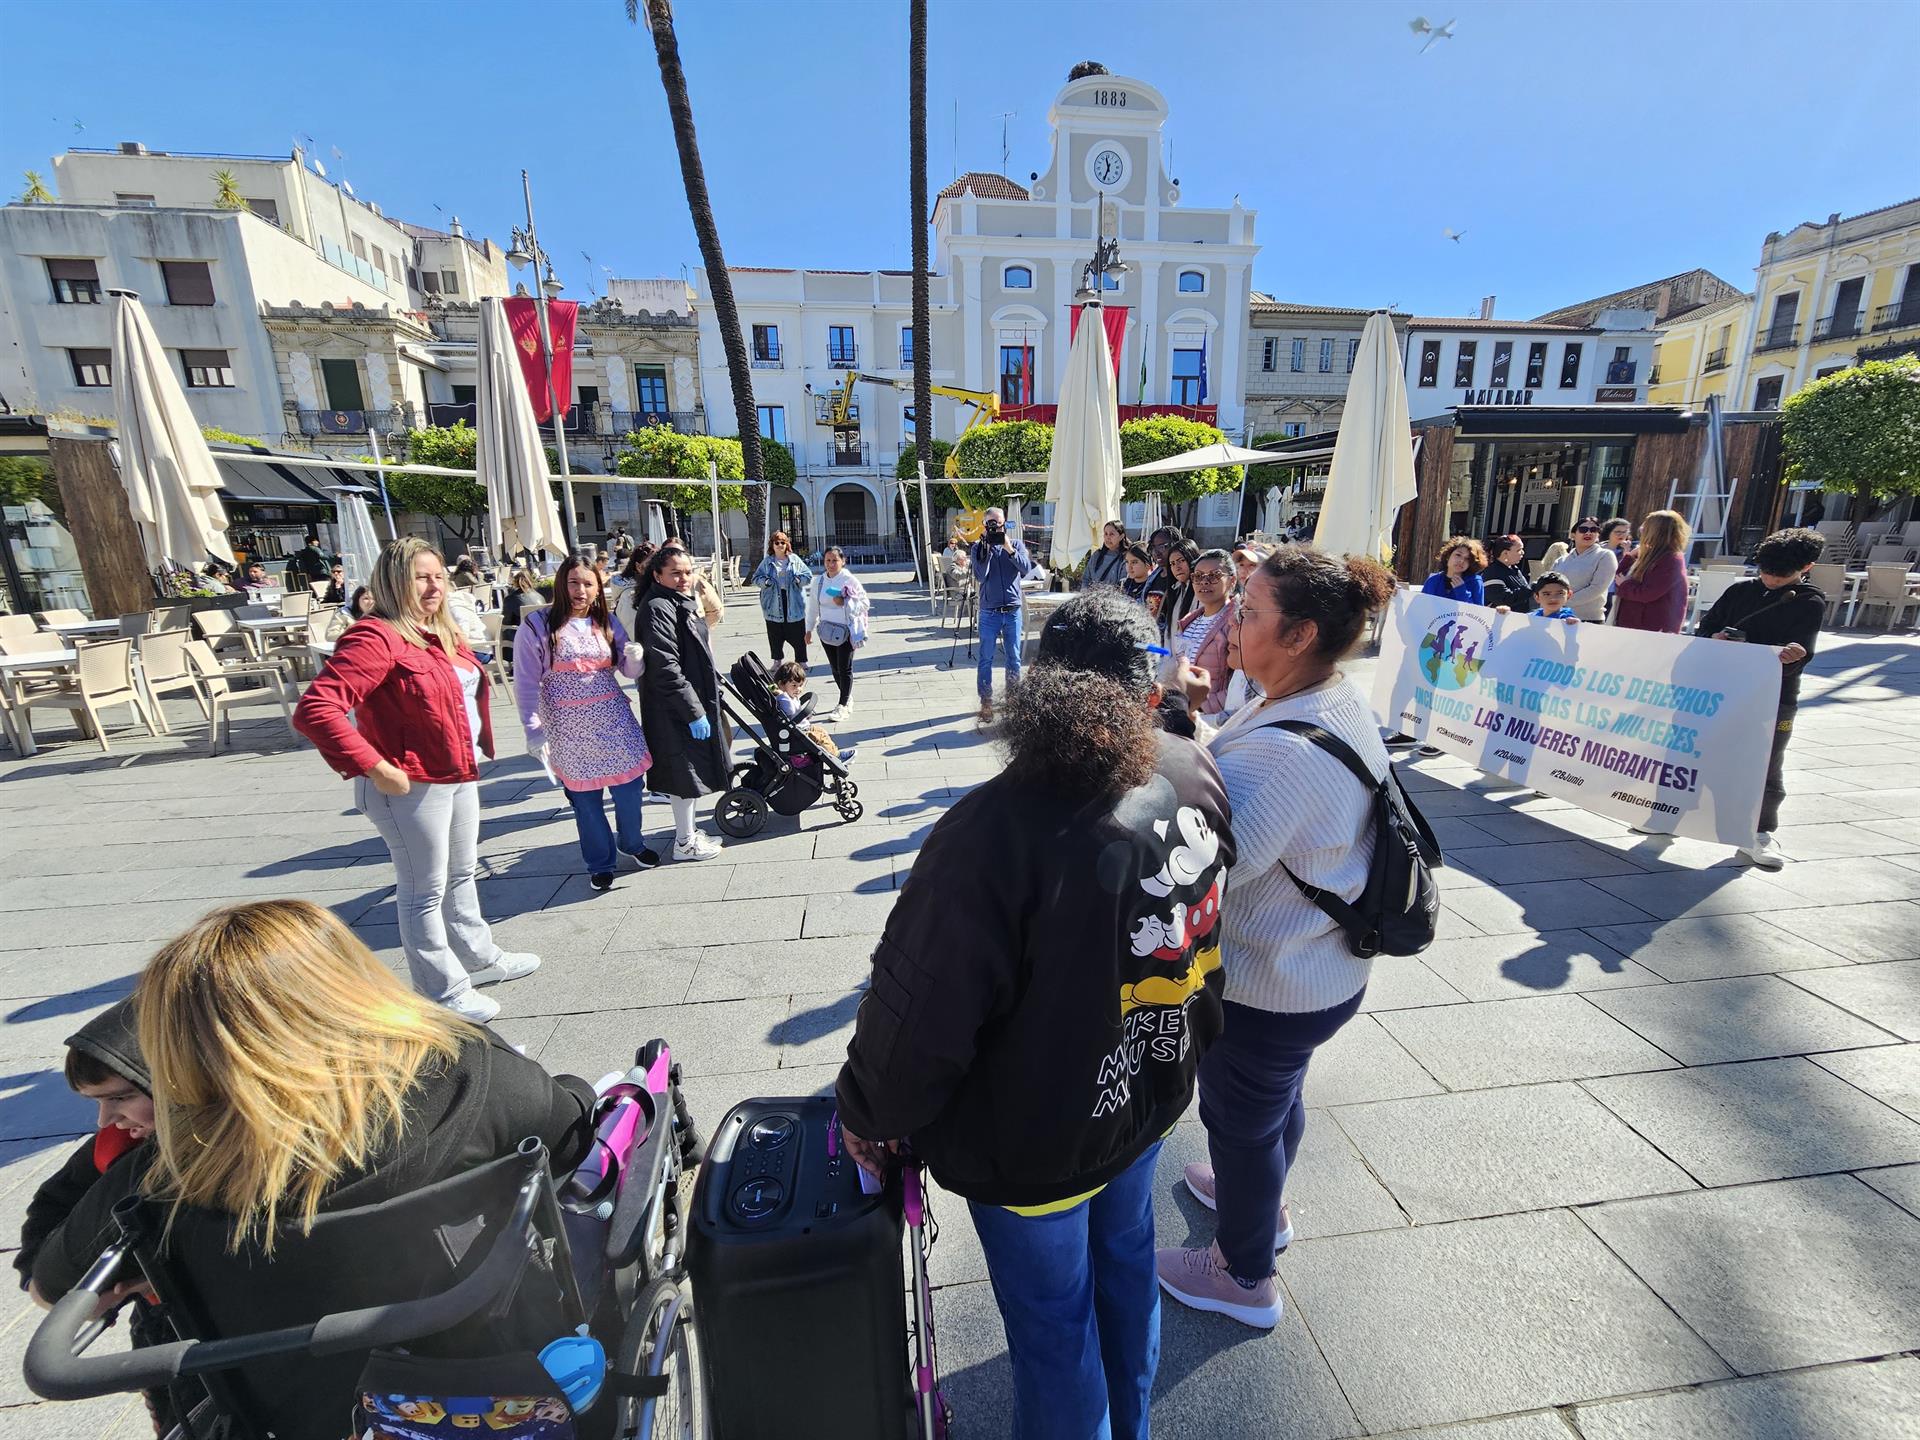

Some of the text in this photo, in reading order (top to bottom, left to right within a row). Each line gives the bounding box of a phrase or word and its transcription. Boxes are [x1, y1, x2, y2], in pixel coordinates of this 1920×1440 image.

[1094, 90, 1126, 107] 1883
[1464, 389, 1534, 405] MALABAR
[1522, 658, 1725, 717] ¡TODOS LOS DERECHOS
[1479, 678, 1702, 759] PARA TODAS LAS MUJERES,
[1415, 686, 1698, 792] INCLUIDAS LAS MUJERES MIGRANTES!
[1493, 748, 1527, 765] #20Junio
[1610, 790, 1680, 815] #18Diciembre
